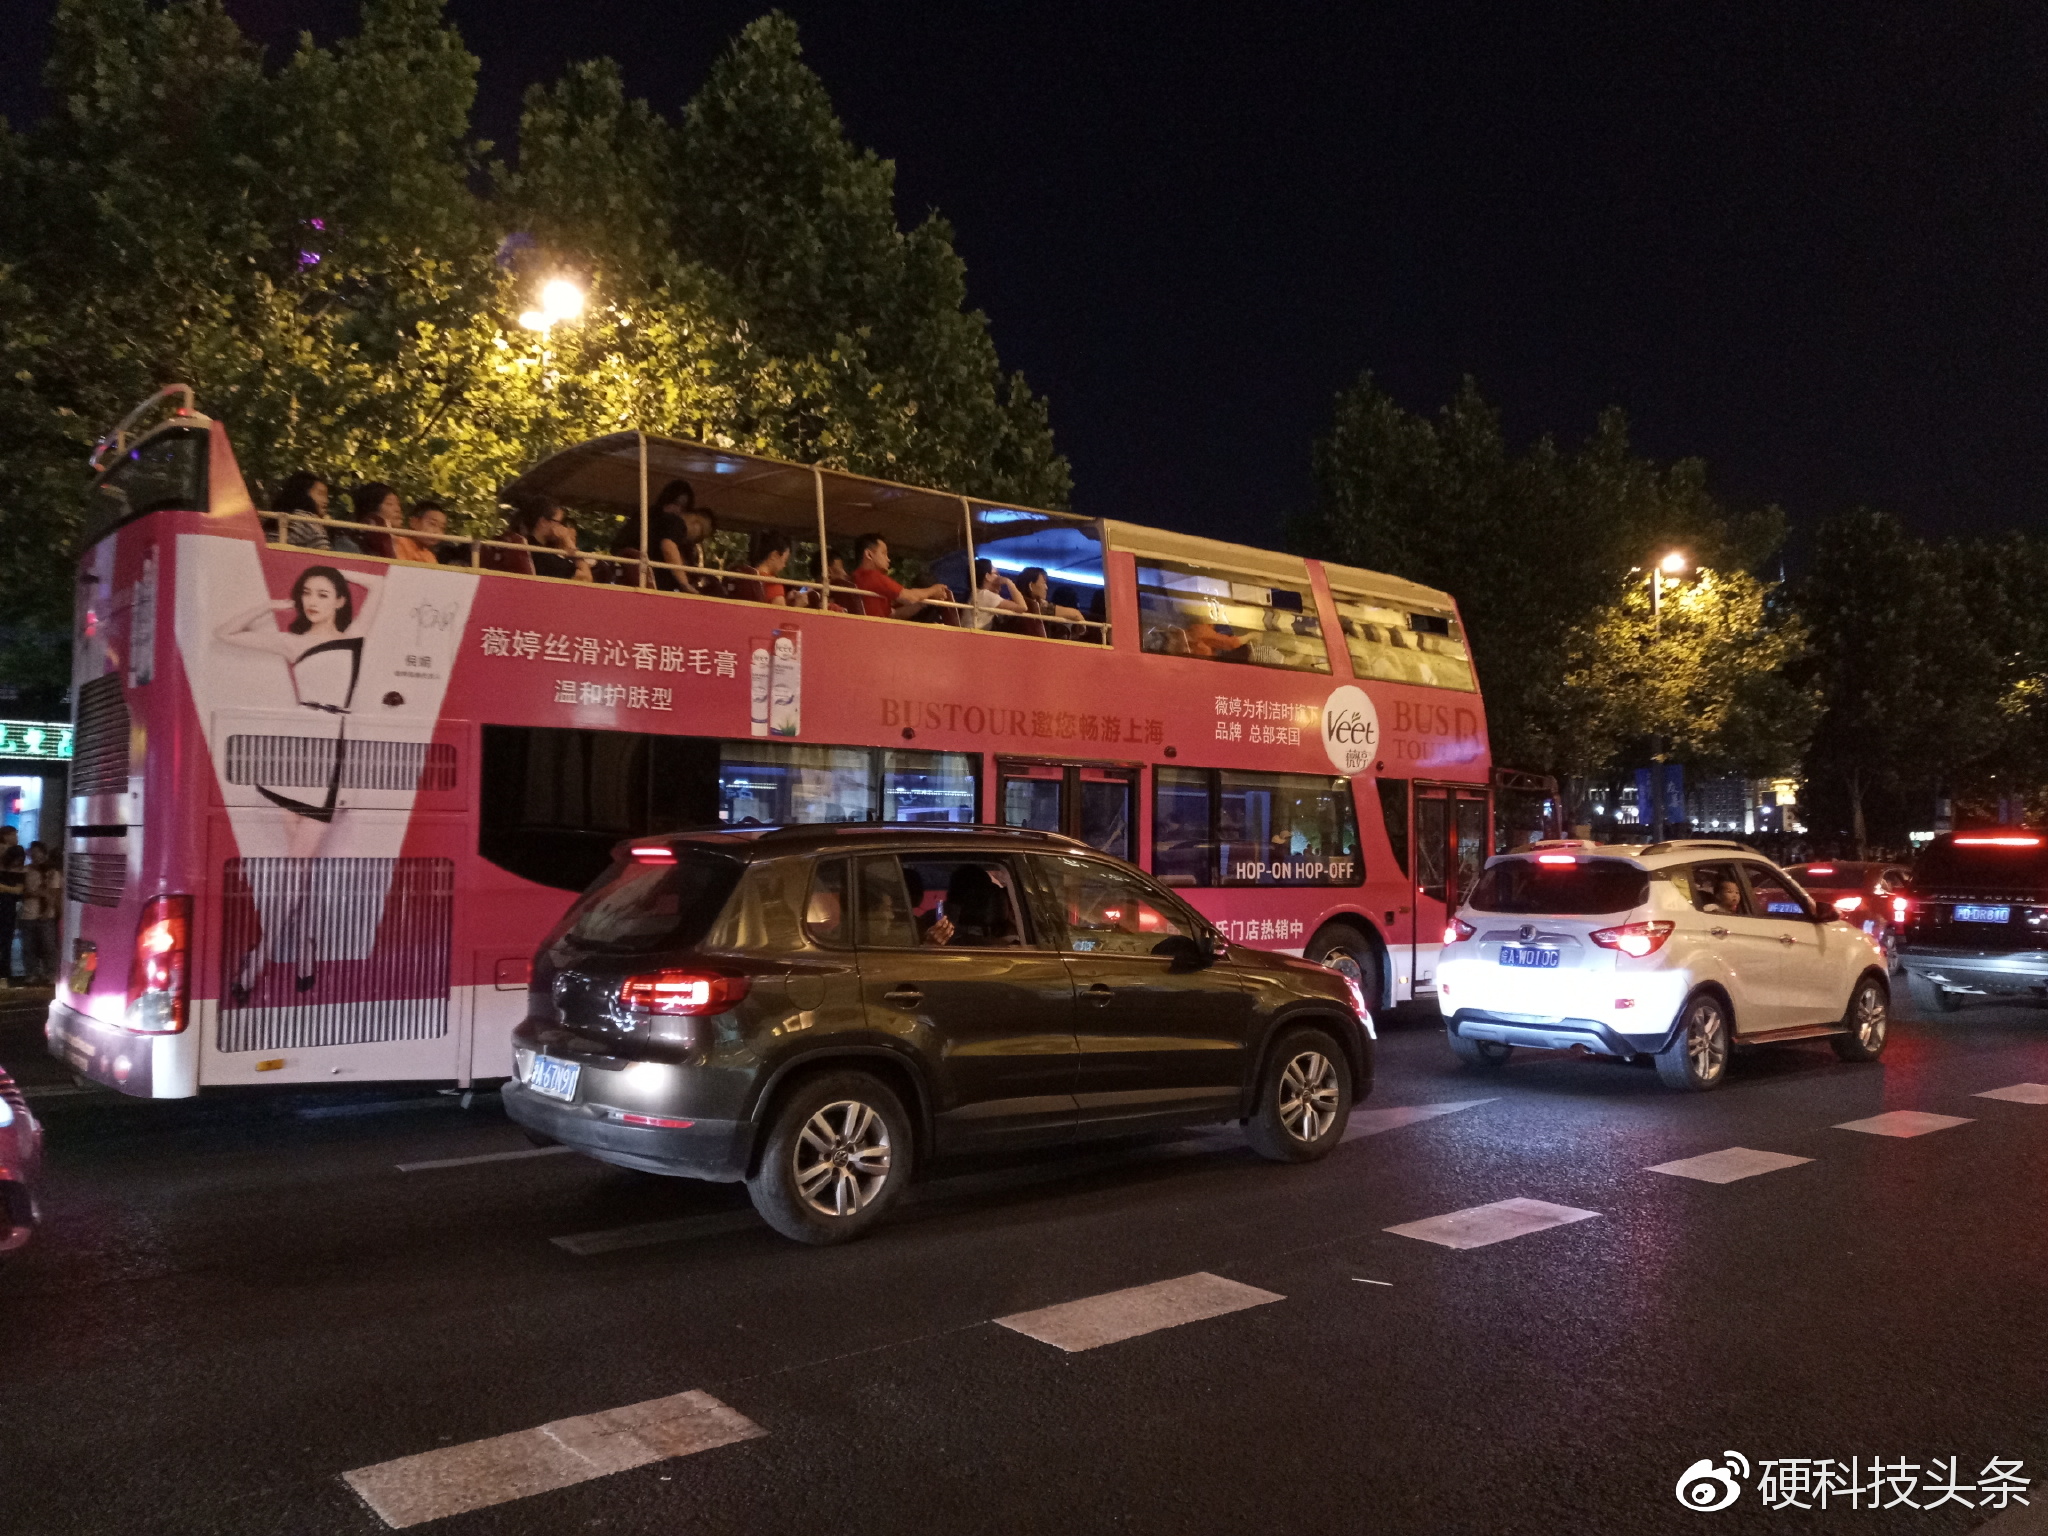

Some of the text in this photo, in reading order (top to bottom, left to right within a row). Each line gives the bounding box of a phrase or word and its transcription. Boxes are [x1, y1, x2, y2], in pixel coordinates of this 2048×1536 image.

[480, 627, 738, 678] 薇婷丝滑沁香脱毛膏
[554, 680, 673, 711] 温和护肤型
[1214, 695, 1320, 723] 薇婷为利洁时旗下
[1215, 721, 1300, 746] 品牌 总部英国
[1327, 709, 1376, 745] Veet
[1393, 701, 1449, 737] BUS
[1236, 862, 1354, 880] HOP-ON HOP-OFF
[1210, 918, 1304, 941] 氏门店热销中
